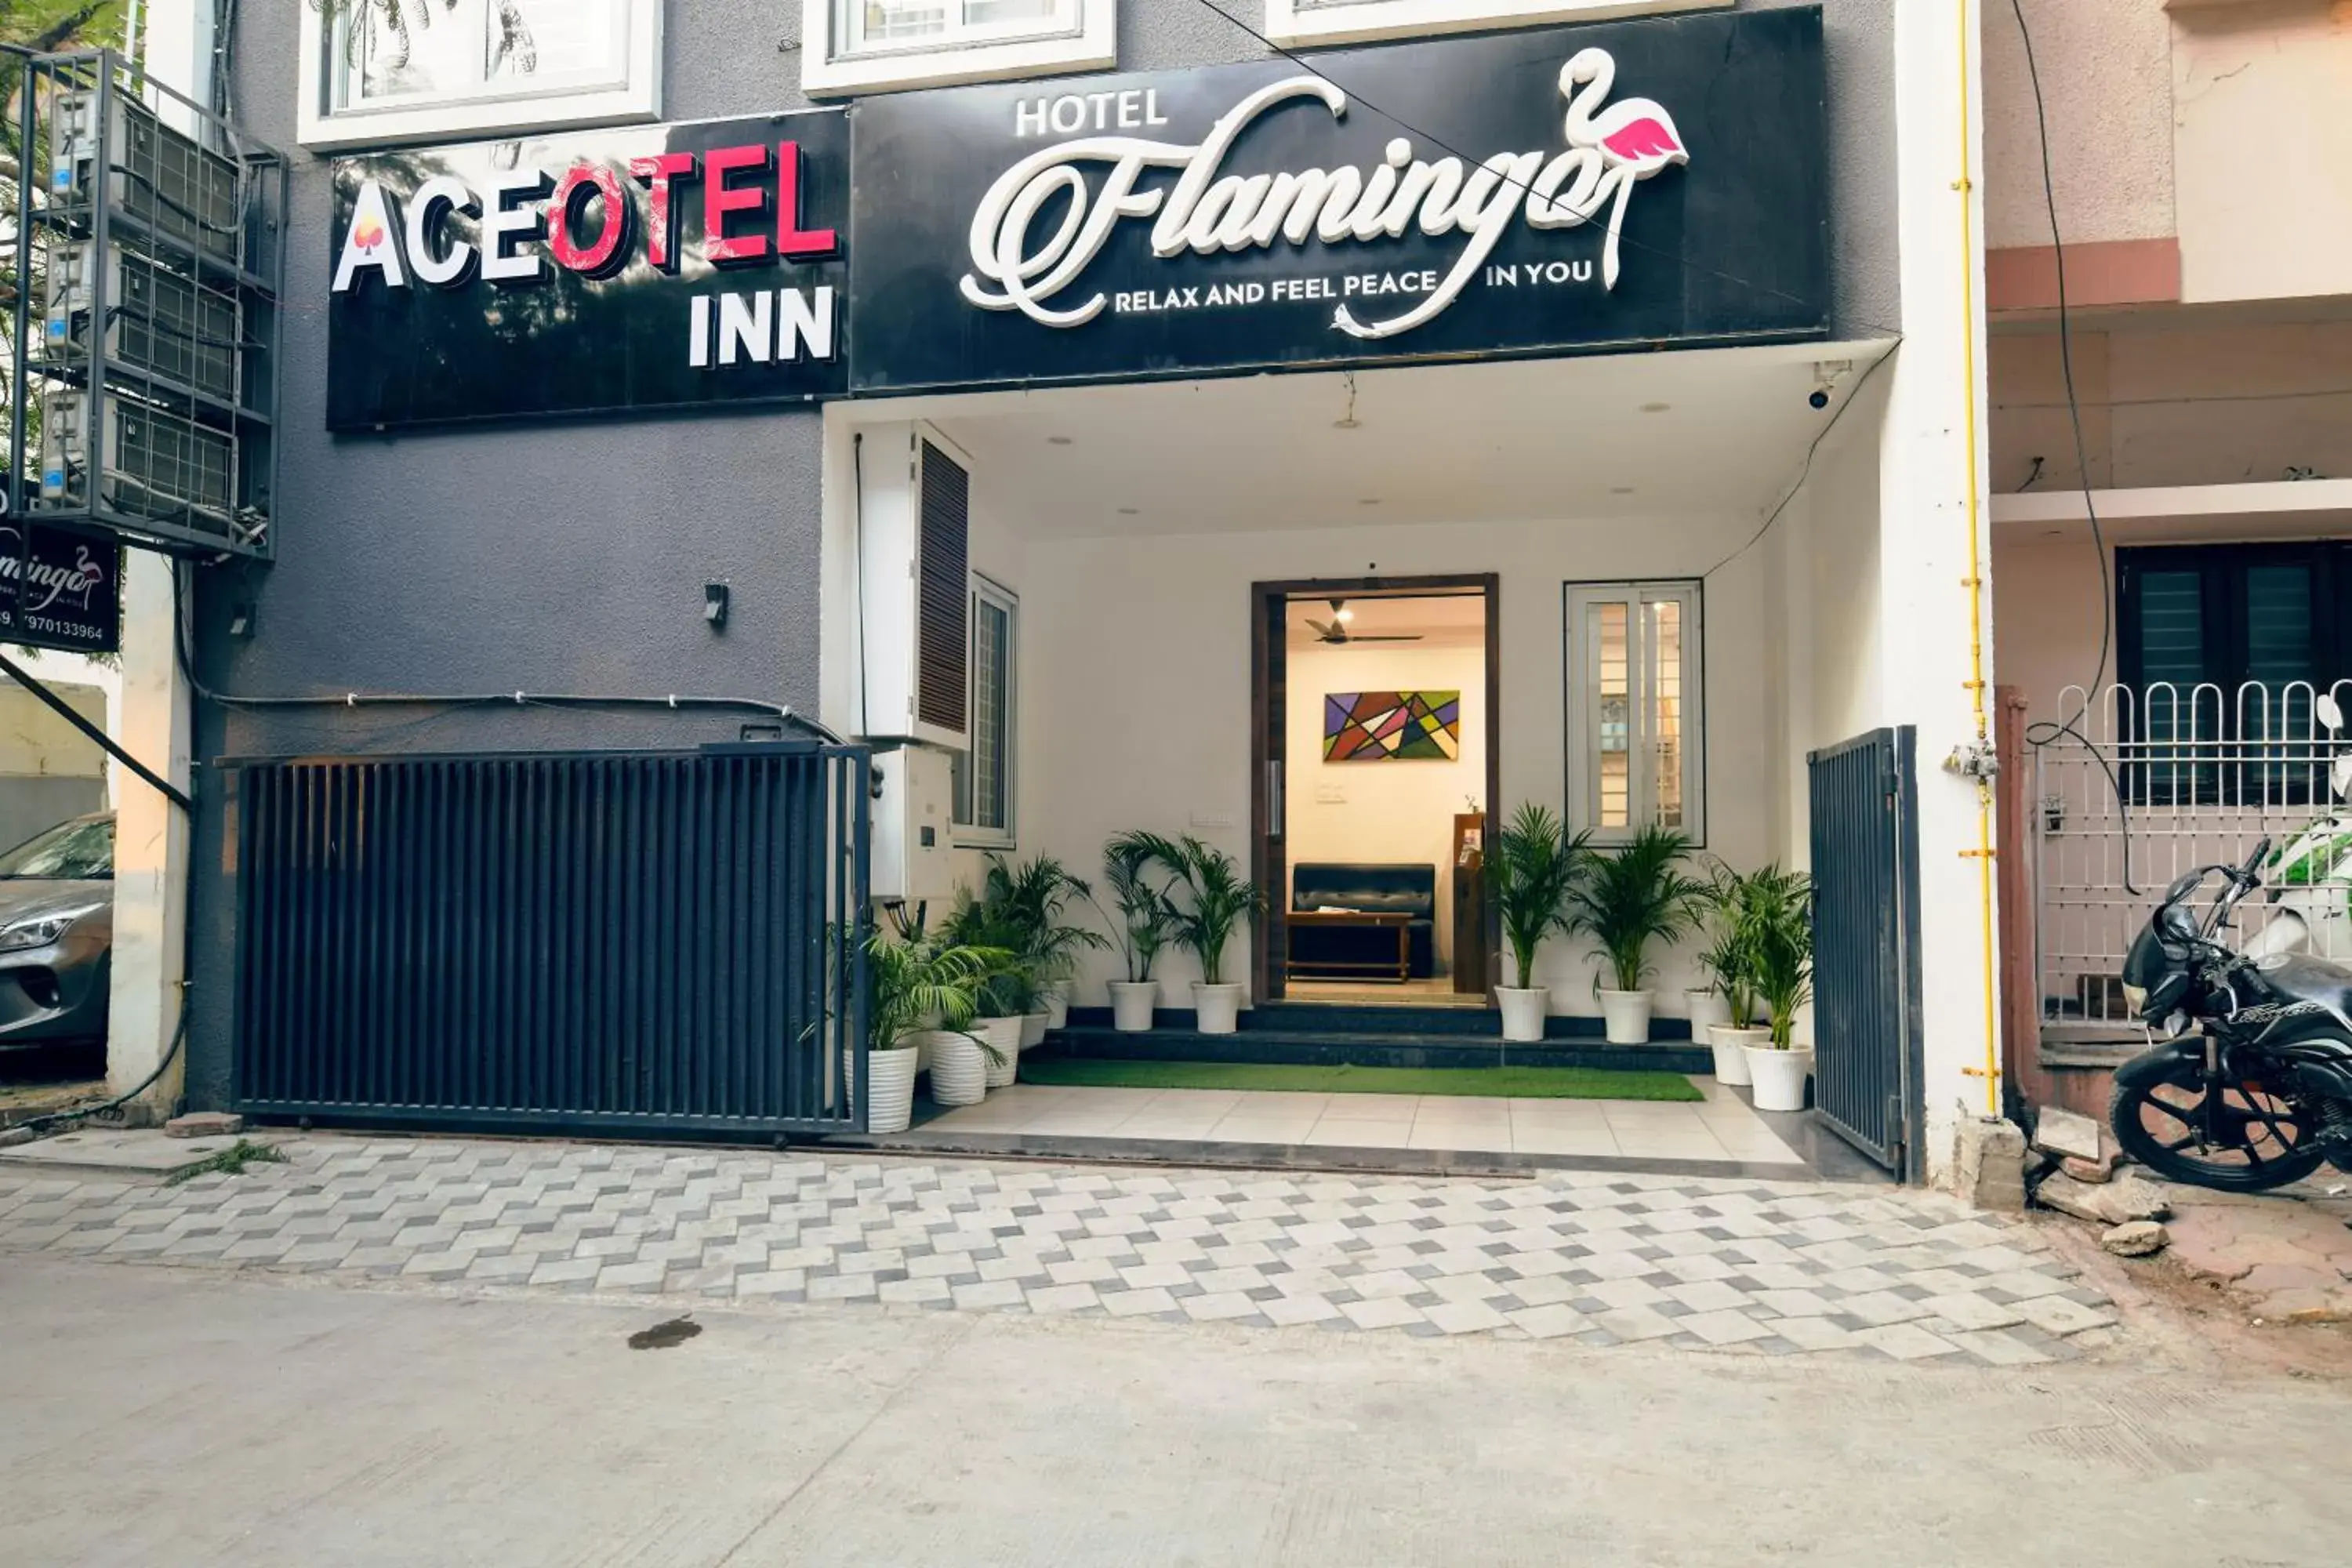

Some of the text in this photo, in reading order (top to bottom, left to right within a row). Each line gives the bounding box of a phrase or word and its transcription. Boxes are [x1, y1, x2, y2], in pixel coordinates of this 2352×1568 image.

[1015, 88, 1169, 137] HOTEL
[332, 140, 837, 292] ACEOTEL
[959, 76, 1629, 339] Flamingo
[1115, 260, 1592, 313] RELAX AND FEEL PEACE IN YOU
[689, 286, 834, 368] INN
[25, 615, 103, 641] 970133964
